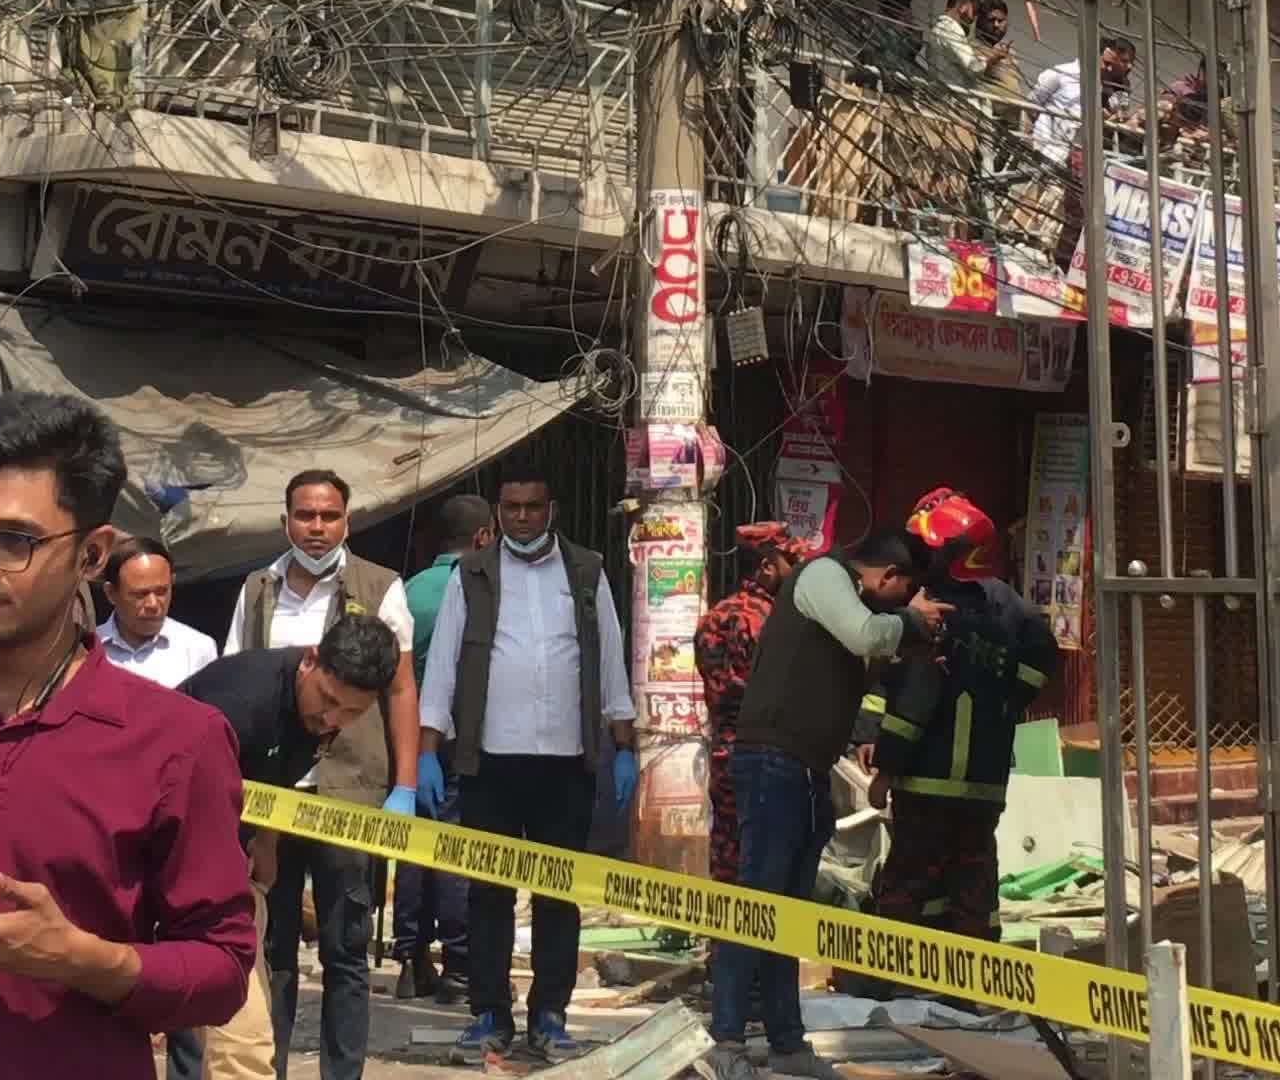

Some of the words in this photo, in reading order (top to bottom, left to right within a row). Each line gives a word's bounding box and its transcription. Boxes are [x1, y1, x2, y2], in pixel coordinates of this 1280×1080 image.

[249, 790, 278, 819] CROSS
[295, 802, 320, 831] CRIME
[321, 808, 346, 836] SCENE
[347, 814, 361, 839] DO
[363, 817, 381, 844] NOT
[383, 820, 410, 852] CROSS
[433, 833, 464, 865] CRIME
[465, 840, 498, 873] SCENE
[500, 847, 517, 877] DO
[518, 851, 537, 882] NOT
[539, 857, 575, 893] CROSS
[604, 871, 642, 908] CRIME
[644, 879, 682, 918] SCENE
[684, 888, 704, 923] DO
[707, 893, 732, 930] NOT
[734, 900, 777, 943] CROSS
[816, 919, 864, 962] CRIME
[867, 929, 915, 976] SCENE
[919, 946, 942, 984] DO
[945, 951, 976, 993] NOT
[980, 960, 1037, 1006] CROSS
[1087, 981, 1150, 1036] CRIME
[1220, 1012, 1252, 1057] DO
